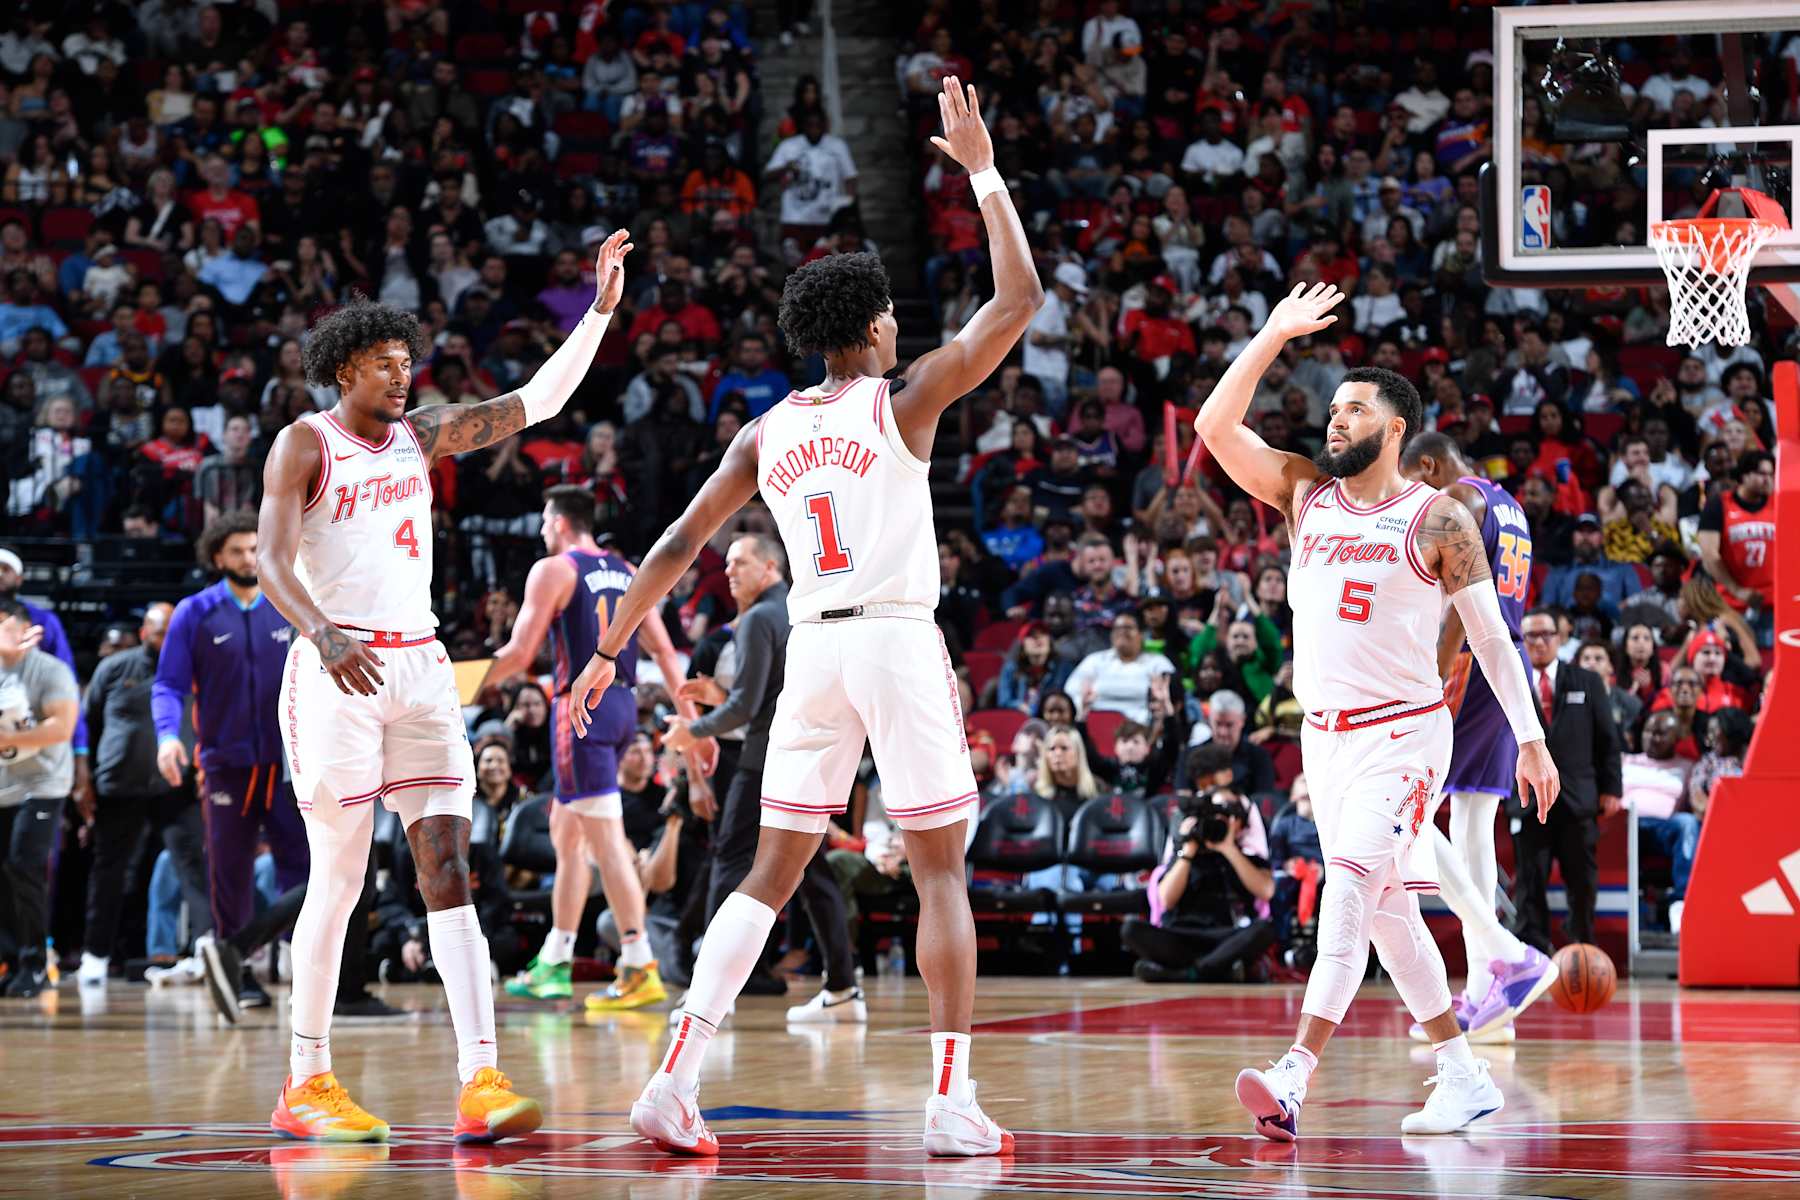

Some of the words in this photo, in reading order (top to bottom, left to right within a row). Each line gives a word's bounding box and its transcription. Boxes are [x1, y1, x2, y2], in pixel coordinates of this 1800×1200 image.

[394, 446, 416, 455] credit
[767, 437, 877, 496] THOMPSON
[330, 473, 424, 524] H-Town
[1379, 516, 1408, 527] credit
[392, 516, 421, 560] 4
[804, 491, 854, 576] 1
[1297, 533, 1400, 569] H-Town
[1375, 522, 1405, 534] karma
[1497, 531, 1532, 602] 35
[1336, 577, 1376, 625] 5
